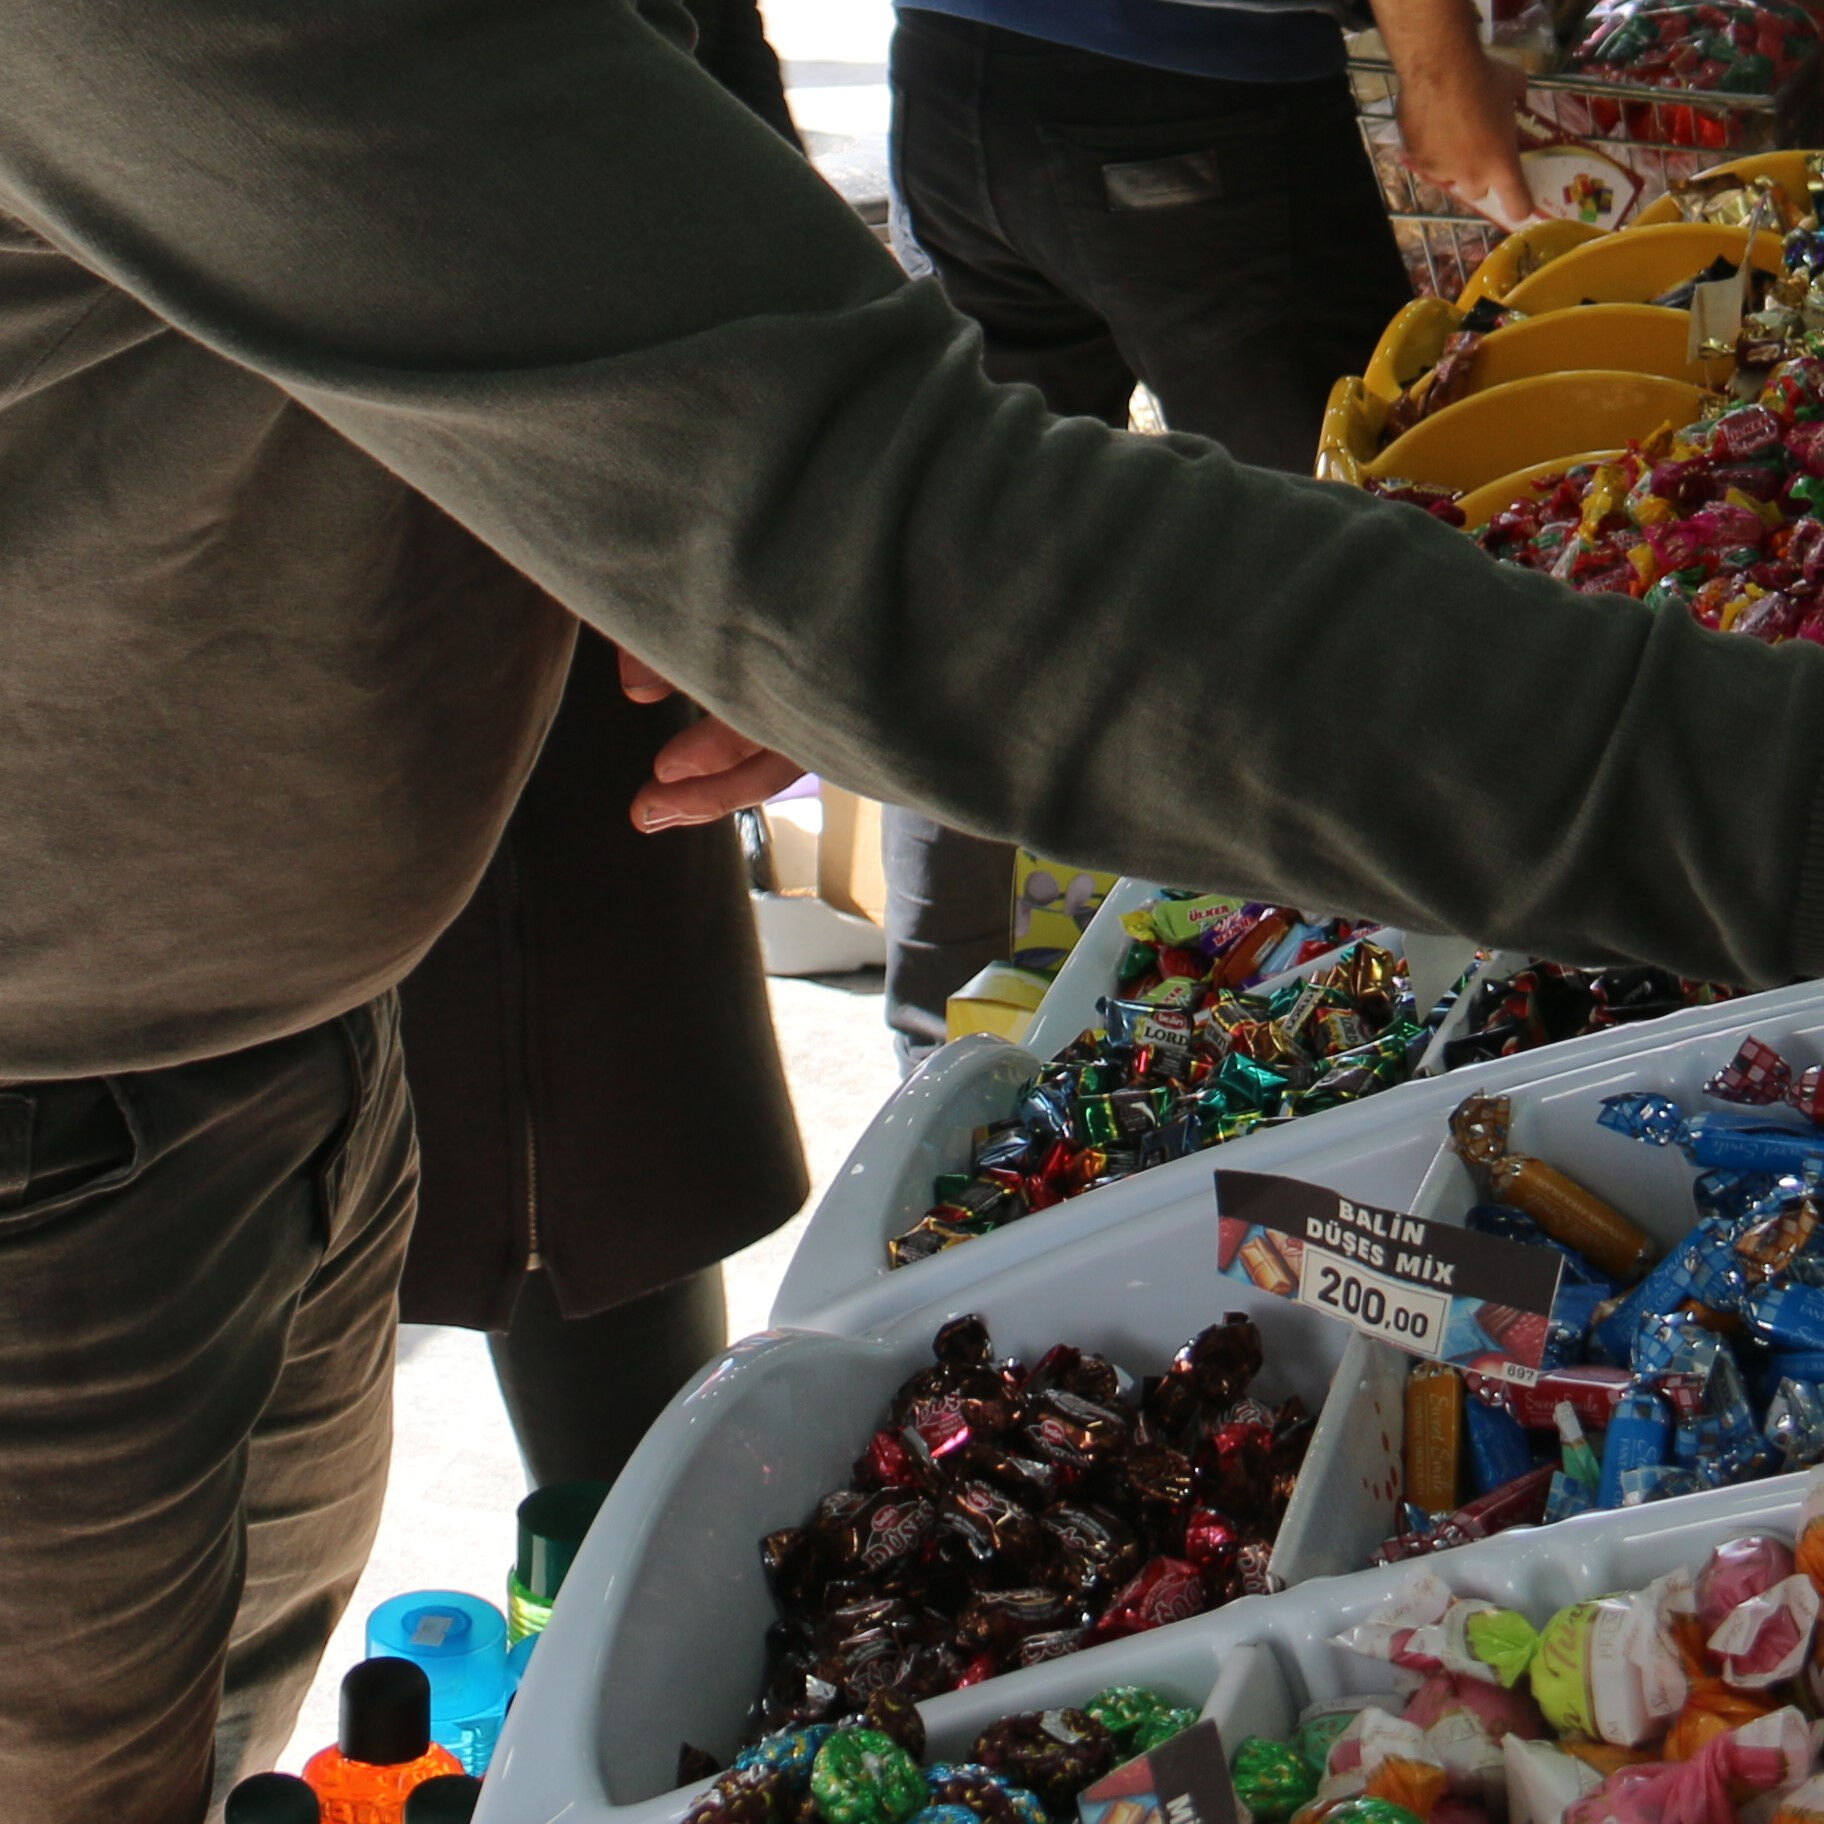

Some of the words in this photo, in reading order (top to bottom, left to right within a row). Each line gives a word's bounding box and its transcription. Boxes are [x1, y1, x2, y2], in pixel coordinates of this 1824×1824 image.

[1143, 1026, 1190, 1047] LORD
[1305, 1217, 1386, 1266] DÜŞES
[1394, 1251, 1457, 1287] MİX
[1337, 1199, 1427, 1248] BALİN
[1316, 1265, 1430, 1340] 200,00
